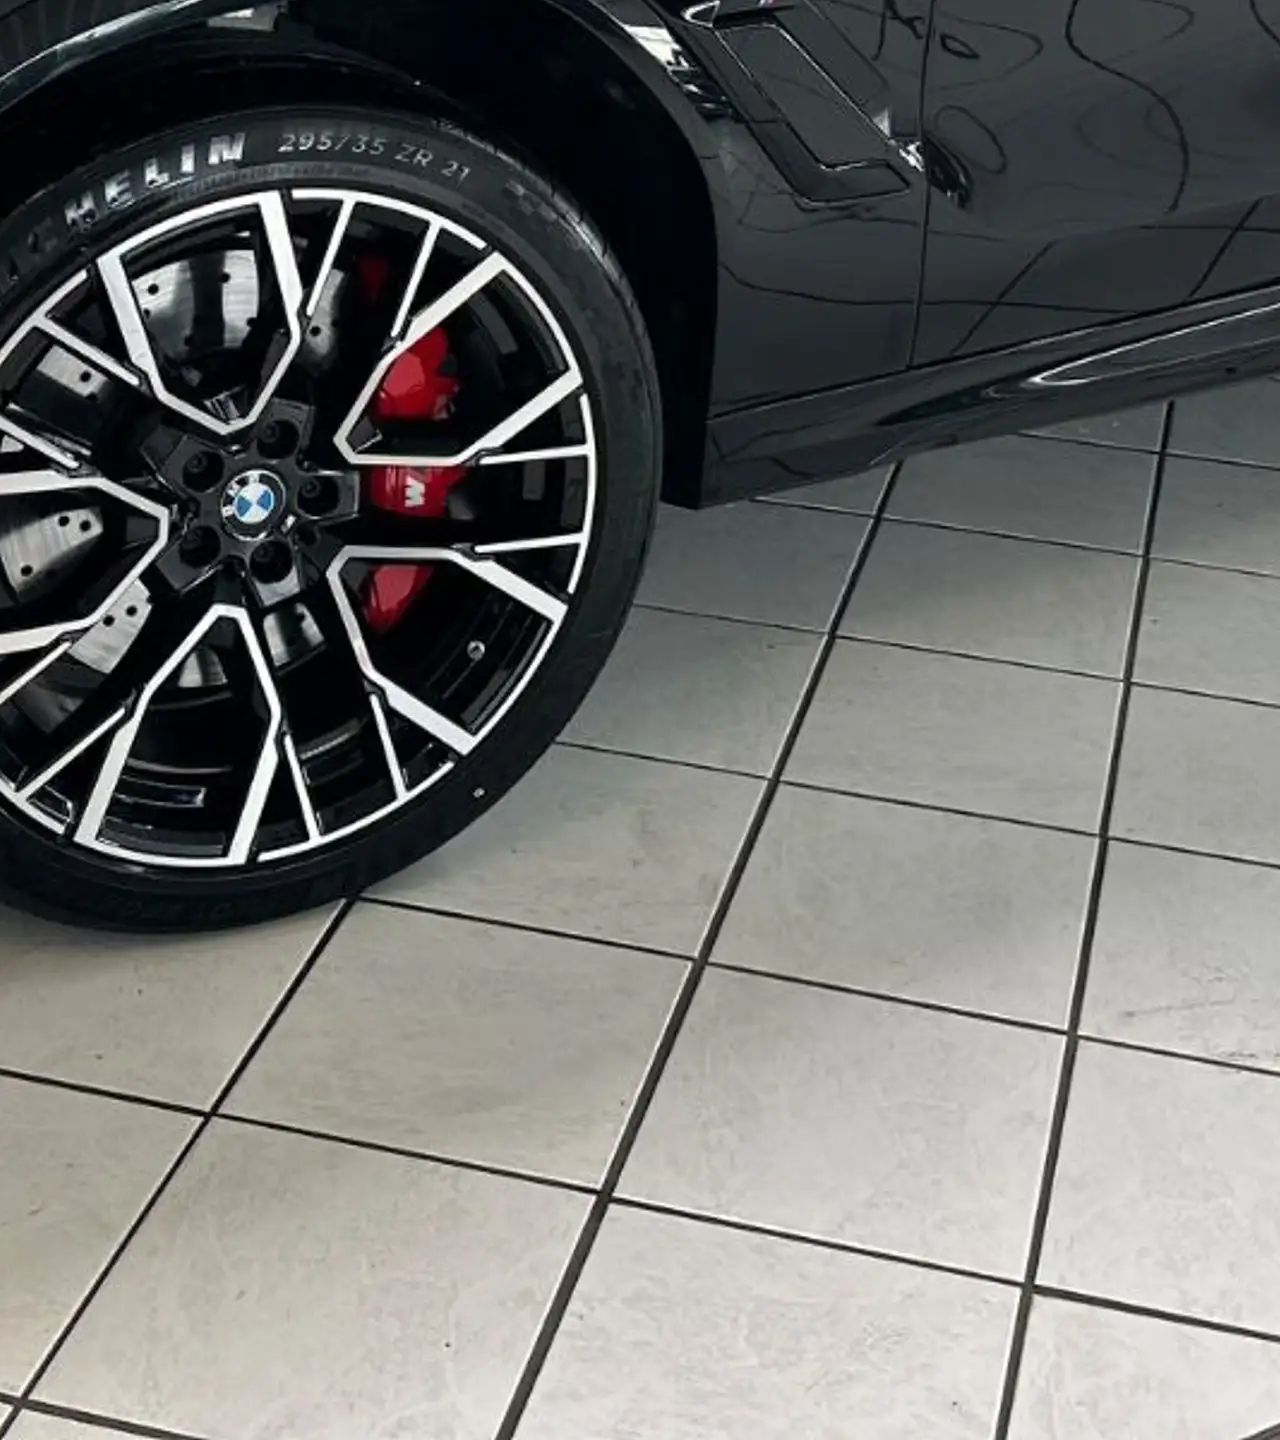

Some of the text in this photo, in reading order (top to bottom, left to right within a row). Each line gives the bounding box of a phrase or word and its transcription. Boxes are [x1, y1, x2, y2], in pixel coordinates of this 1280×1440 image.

[277, 133, 470, 181] 295/35 ZR 21
